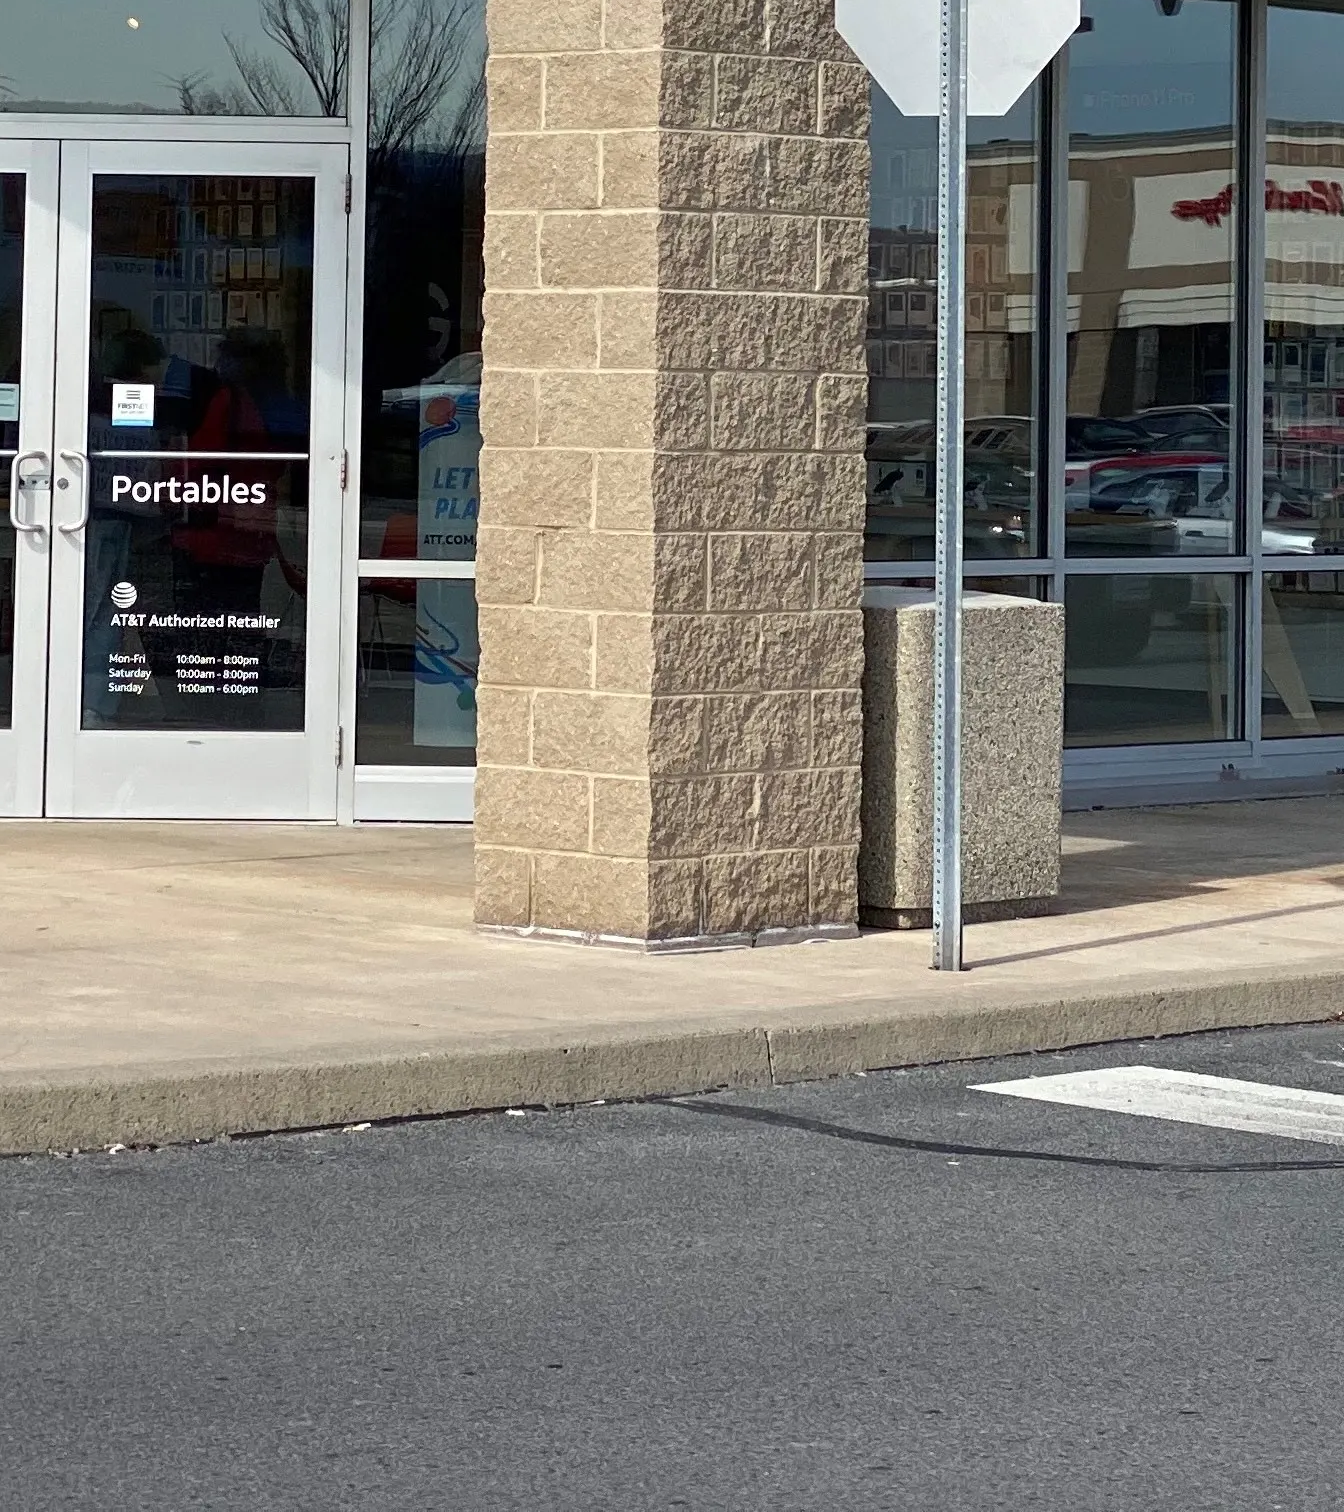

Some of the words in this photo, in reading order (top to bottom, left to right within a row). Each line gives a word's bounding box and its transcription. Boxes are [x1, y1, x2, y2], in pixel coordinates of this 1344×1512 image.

[112, 474, 267, 505] Portables
[110, 613, 146, 628] AT&T
[149, 614, 224, 628] Authorized
[227, 615, 281, 629] Retailer
[108, 653, 146, 664] Mon-Fri
[176, 654, 216, 664] 10:00am
[223, 655, 259, 667] 8:00pm
[108, 667, 152, 680] Saturday
[175, 669, 215, 679] 10:00am
[222, 669, 259, 681] 8:00pm
[108, 682, 144, 695] Sunday
[176, 683, 215, 694] 11:00am
[223, 684, 259, 696] 6:00pm
